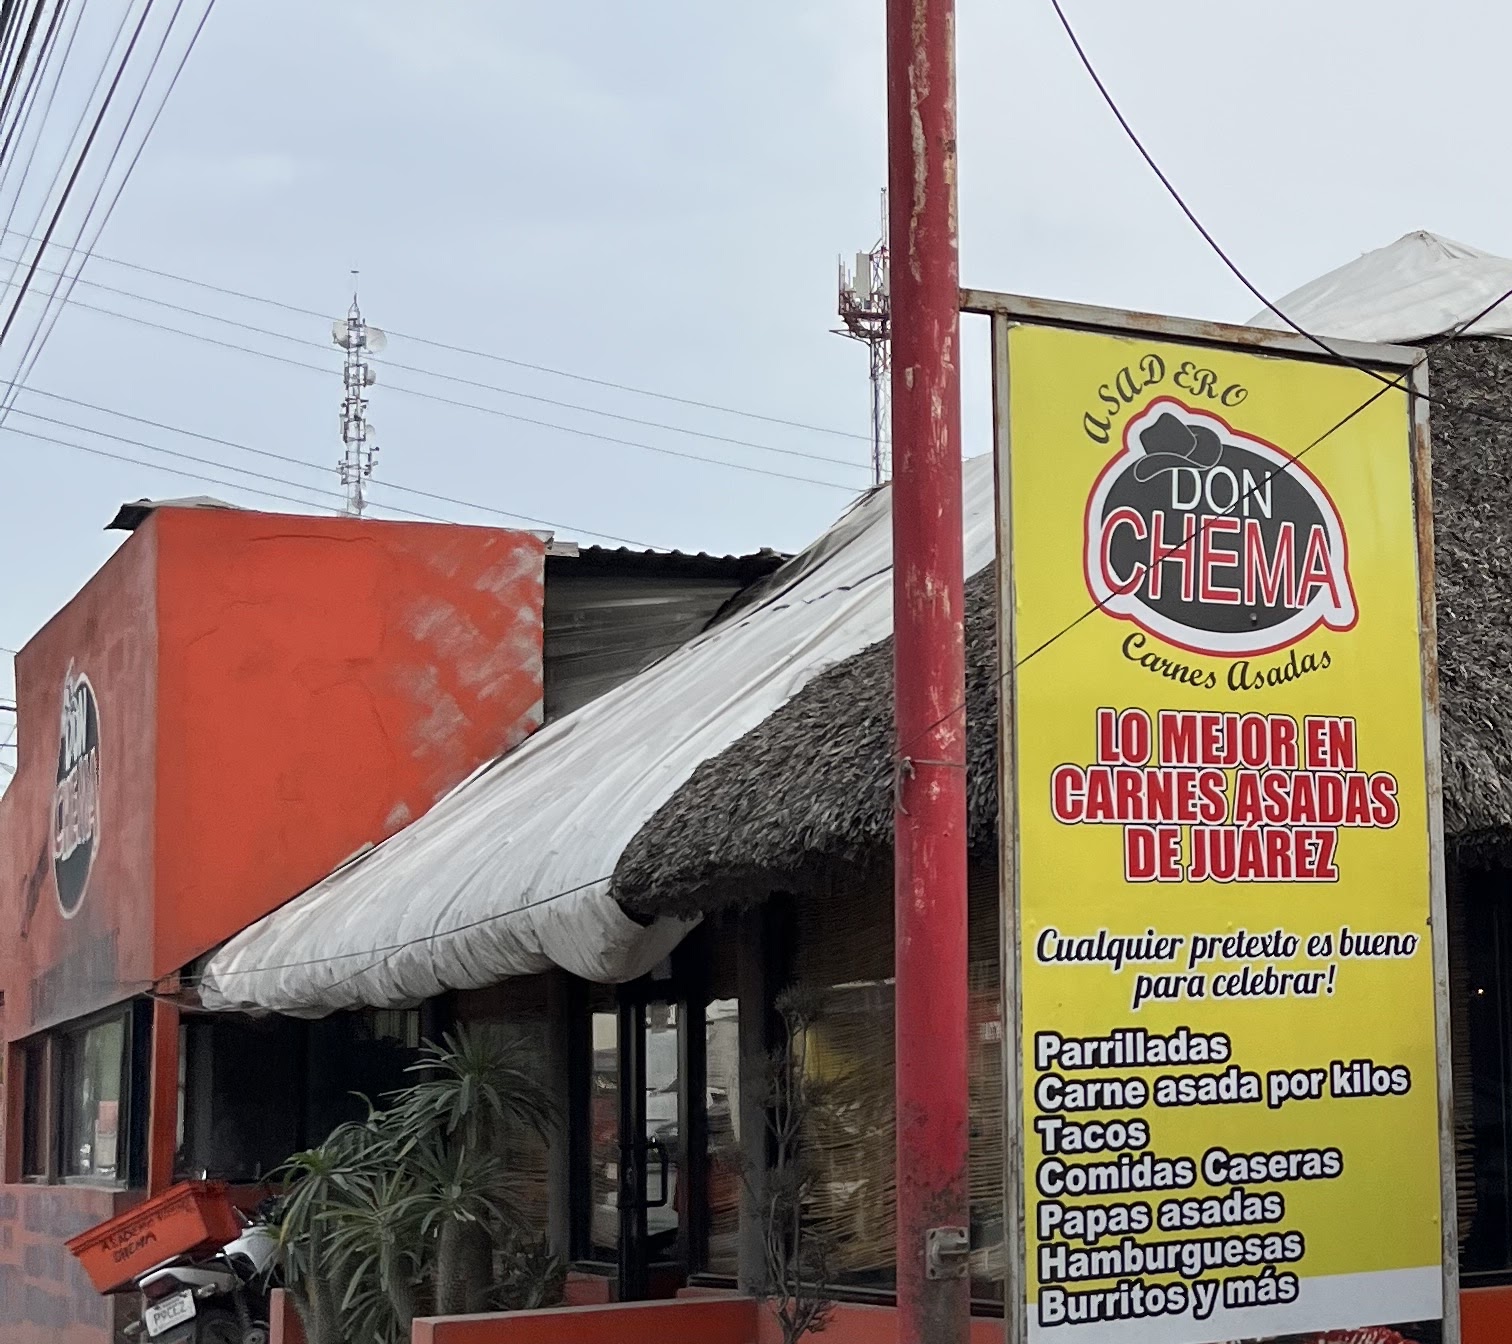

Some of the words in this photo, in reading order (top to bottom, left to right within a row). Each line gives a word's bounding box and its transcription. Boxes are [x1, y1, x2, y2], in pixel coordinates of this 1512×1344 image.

[1083, 353, 1249, 445] ASADERO
[1171, 467, 1272, 518] DON
[1100, 506, 1342, 610] CHEMA
[1122, 632, 1215, 690] Carnes
[1227, 649, 1332, 692] Asadas
[1096, 709, 1150, 767] LO
[1158, 710, 1299, 770] MEJOR
[1304, 716, 1357, 770] EN
[1052, 765, 1227, 823] CARNES
[1235, 769, 1398, 828] ASADAS
[1124, 826, 1185, 881] DE
[1188, 814, 1340, 882] JUÁREZ
[1036, 928, 1184, 973] Cualquier
[1189, 928, 1299, 969] pretexto
[1306, 934, 1334, 959] es
[1339, 922, 1419, 959] bueno
[1133, 970, 1206, 1008] para
[1212, 963, 1337, 997] celebrar!
[1035, 1028, 1230, 1069] Parrilladas
[1035, 1075, 1148, 1112] Carne
[1154, 1064, 1260, 1103] asada
[1268, 1064, 1324, 1107] por
[1330, 1059, 1411, 1096] kilos
[1035, 1118, 1149, 1153] Tacos
[1036, 1156, 1195, 1197] Comidas
[1202, 1147, 1343, 1185] Caseras
[1037, 1199, 1151, 1244] Papas
[1157, 1188, 1285, 1228] asadas
[1037, 1230, 1303, 1281] Hamburguesas
[1037, 1278, 1187, 1326] Burritos
[1194, 1280, 1217, 1319] y
[1225, 1268, 1298, 1308] más
